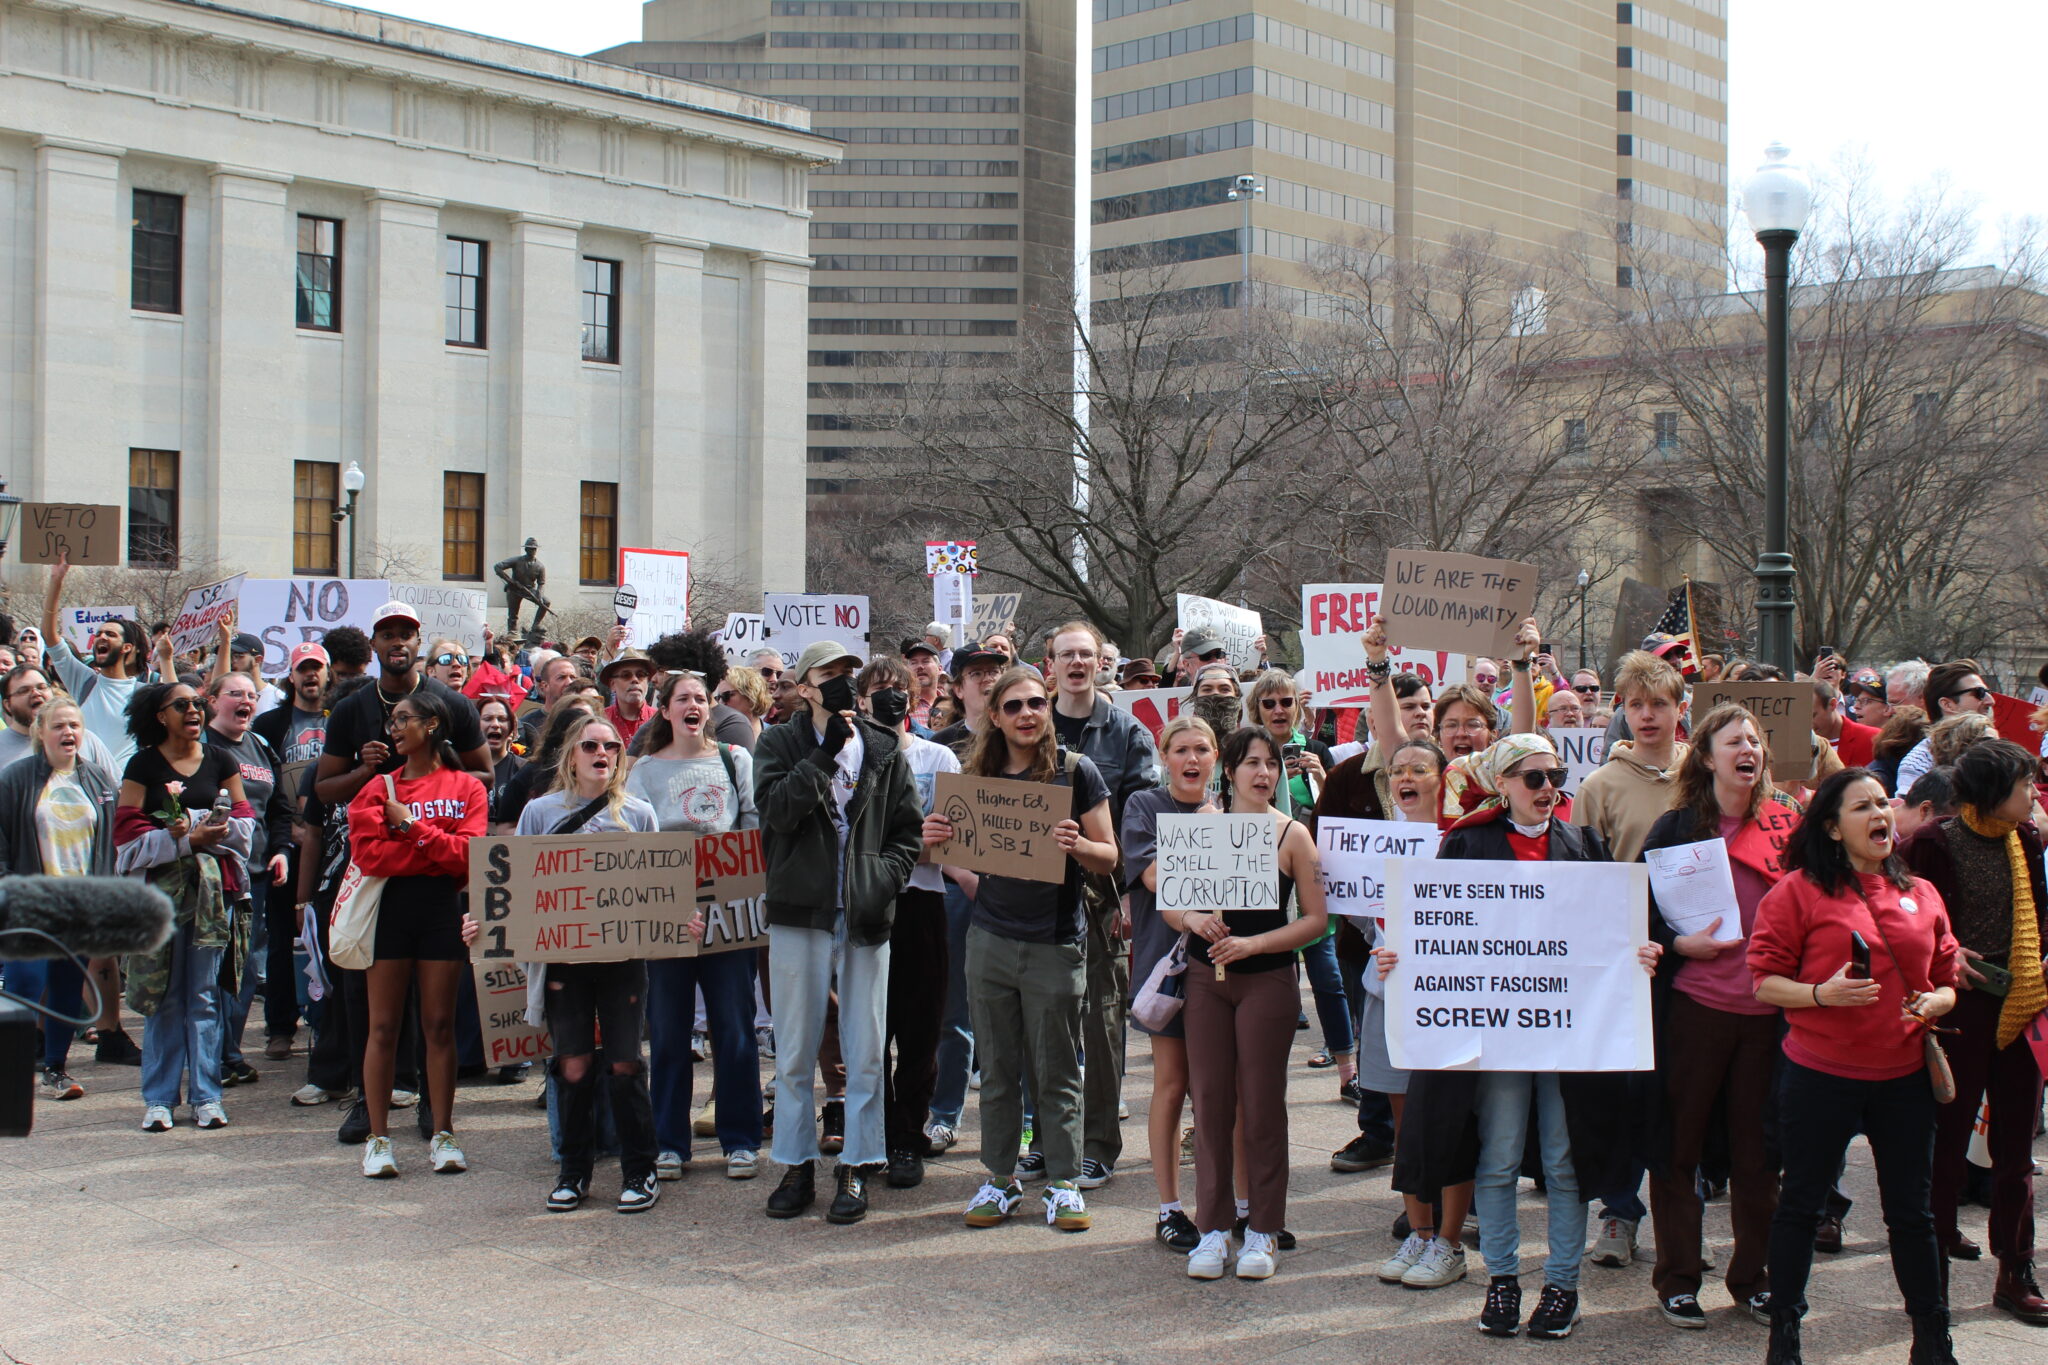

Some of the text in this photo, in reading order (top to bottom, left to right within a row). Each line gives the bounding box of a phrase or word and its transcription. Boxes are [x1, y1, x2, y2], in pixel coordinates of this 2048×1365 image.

[33, 507, 96, 529] VETO
[40, 532, 89, 558] SB 1
[629, 558, 684, 586] Protect the
[1397, 561, 1521, 592] WE ARE THE
[285, 581, 349, 622] NO
[616, 594, 636, 607] RESIST
[987, 595, 1017, 620] NO
[1392, 593, 1438, 617] LOUD
[436, 612, 467, 629] NOT
[773, 603, 861, 629] VOTE NO
[1310, 592, 1378, 636] FREE
[1224, 620, 1256, 638] KILLED
[1316, 667, 1371, 692] HIGHE
[426, 800, 466, 819] STATE
[977, 789, 1020, 806] Higher
[982, 813, 1051, 836] KILLED BY
[1757, 813, 1793, 831] LET
[1158, 824, 1214, 850] WAKE
[1323, 826, 1425, 856] THEY CANT
[532, 848, 693, 880] ANTI-EDUCATION
[1163, 854, 1272, 873] SMELL THE
[535, 886, 675, 914] ANTI-GROWTH
[1161, 876, 1278, 907] CORRUPTION
[1414, 883, 1545, 900] WE'VE SEEN THIS
[1414, 911, 1478, 926] BEFORE.
[535, 920, 690, 951] ANTI-FUTURE
[1415, 940, 1568, 956] ITALIAN SCHOLARS
[485, 969, 527, 987] SILE
[1414, 976, 1568, 993] AGAINST FASCISM!
[1416, 1007, 1572, 1029] SCREW SB1!
[491, 1032, 553, 1062] FUCK
